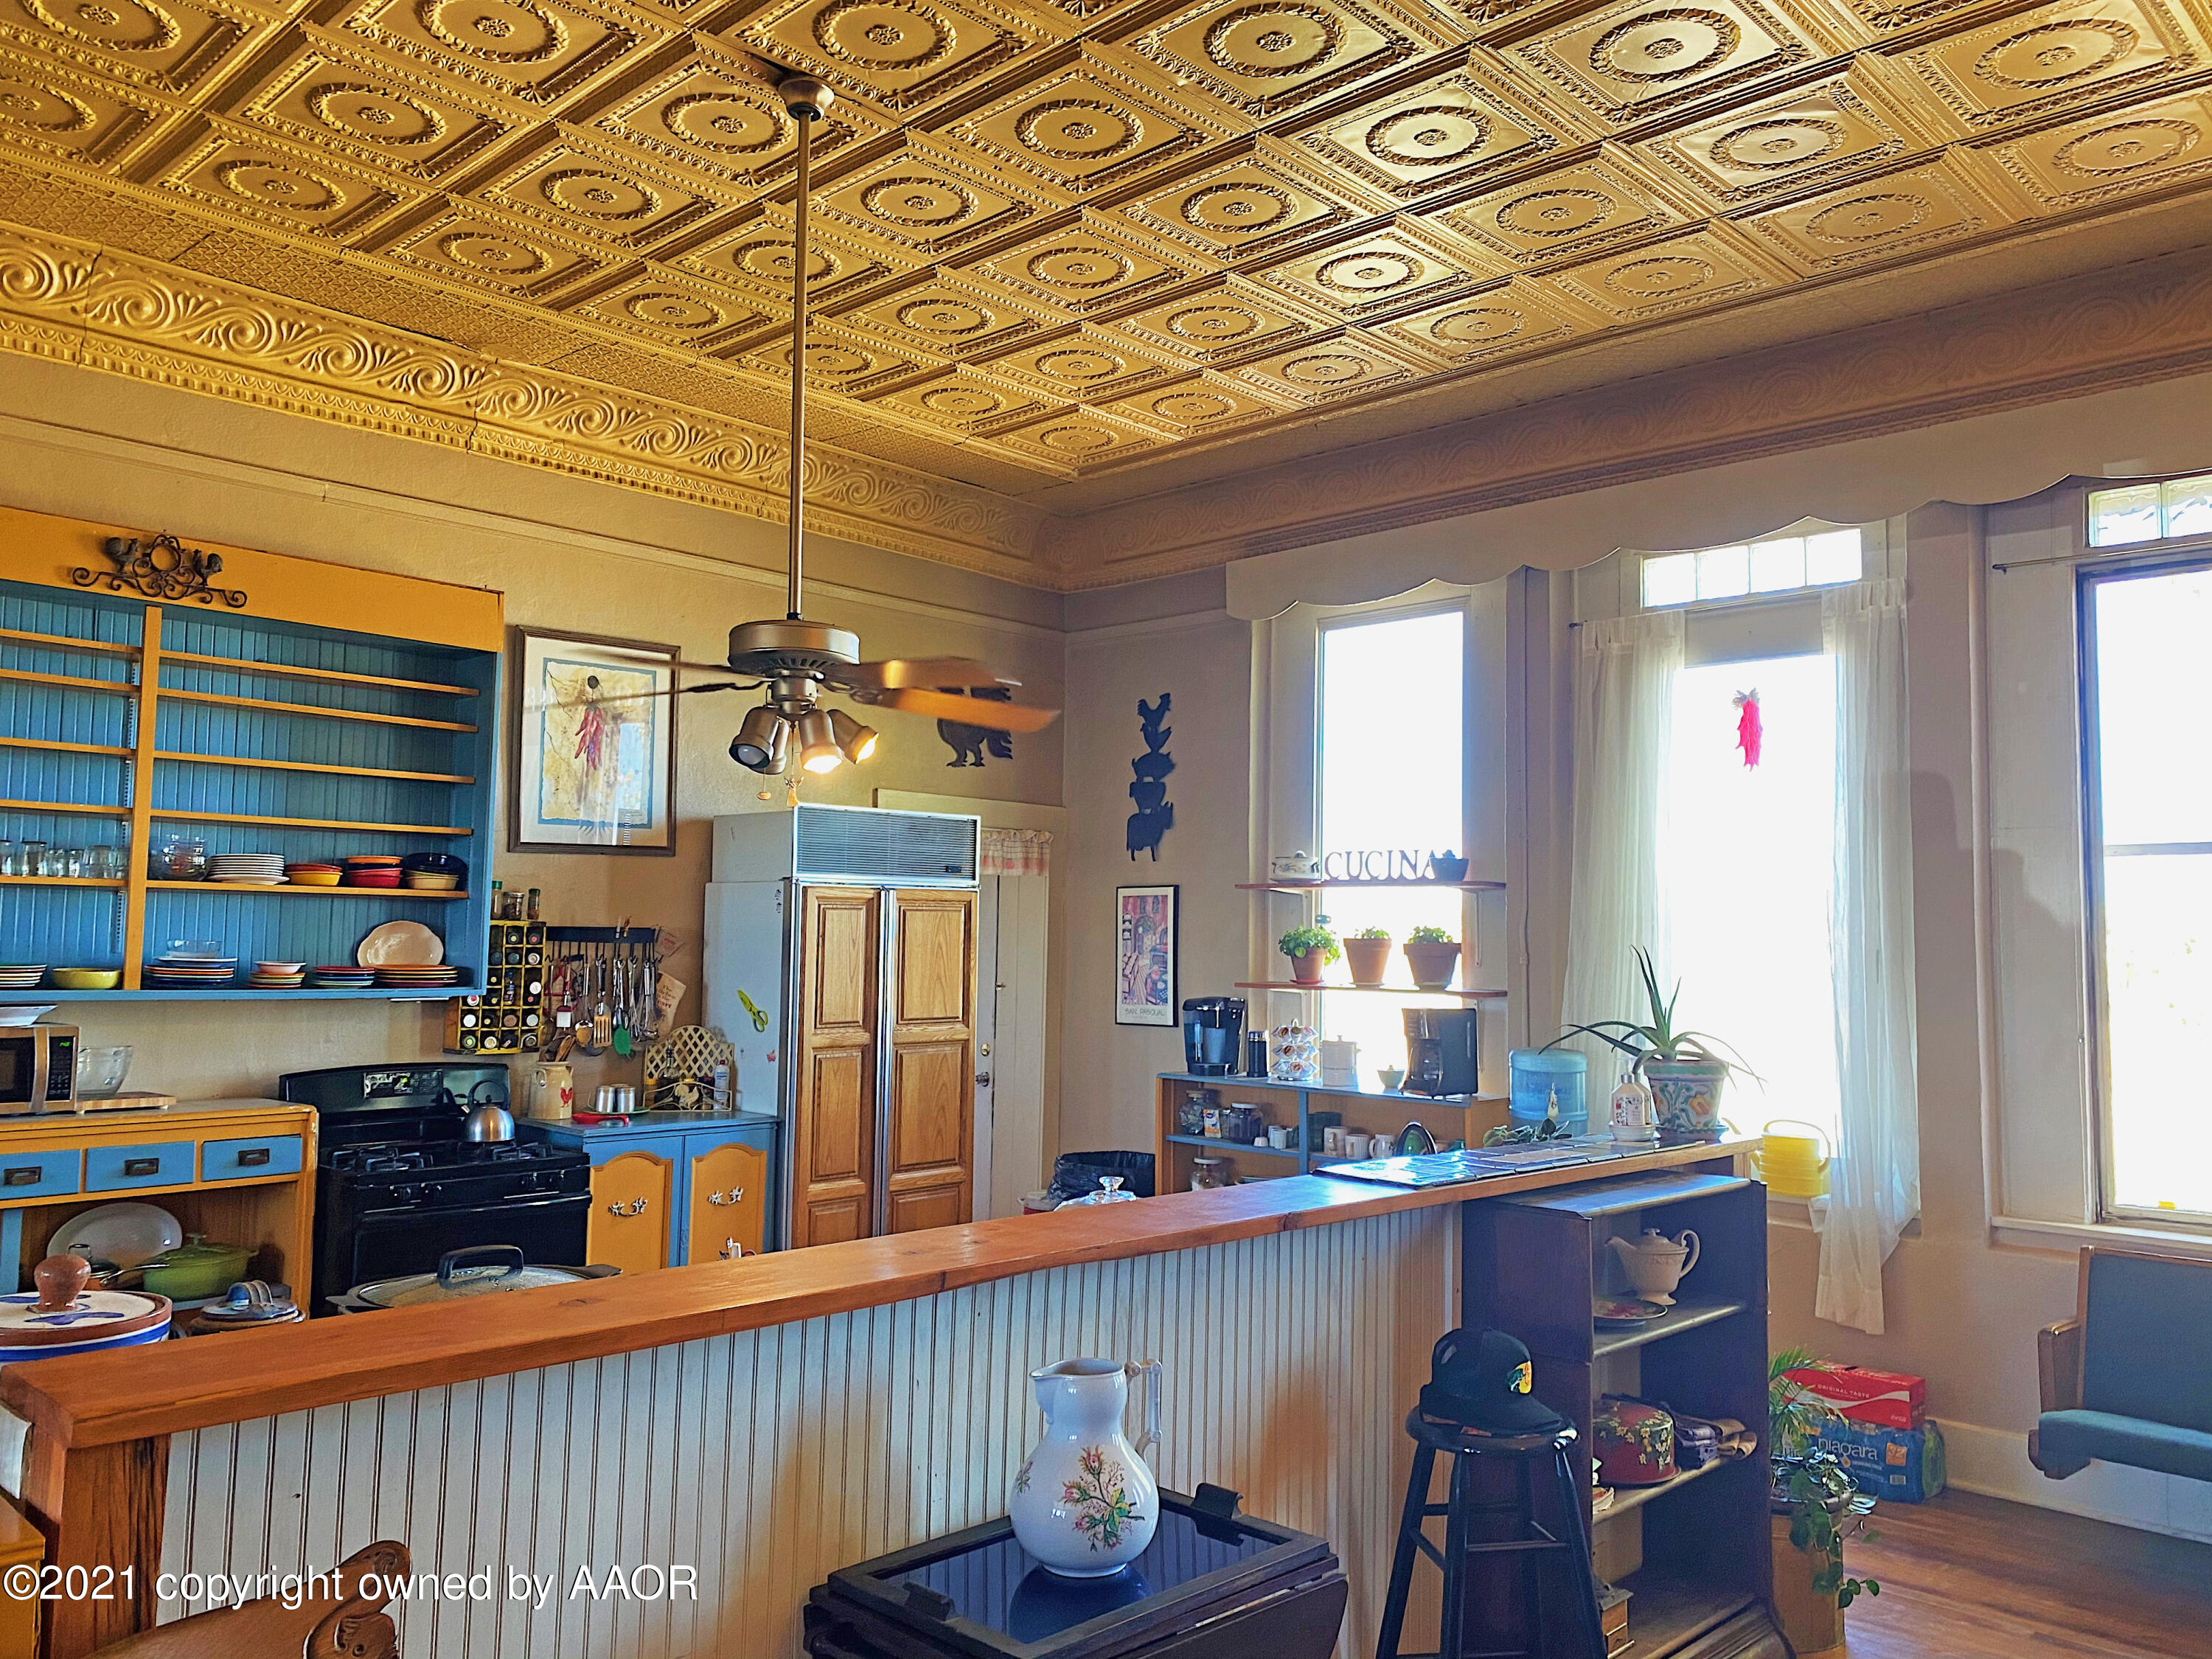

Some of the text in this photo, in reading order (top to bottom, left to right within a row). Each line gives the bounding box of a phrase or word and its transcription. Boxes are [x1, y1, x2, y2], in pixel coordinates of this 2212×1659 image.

[1325, 849, 1436, 880] CUCINA
[1124, 1007, 1165, 1016] SAN PASQUAL
[1817, 1383, 1848, 1395] ORIGINAL
[1850, 1391, 1870, 1399] TASTE
[1818, 1438, 1877, 1461] niagara
